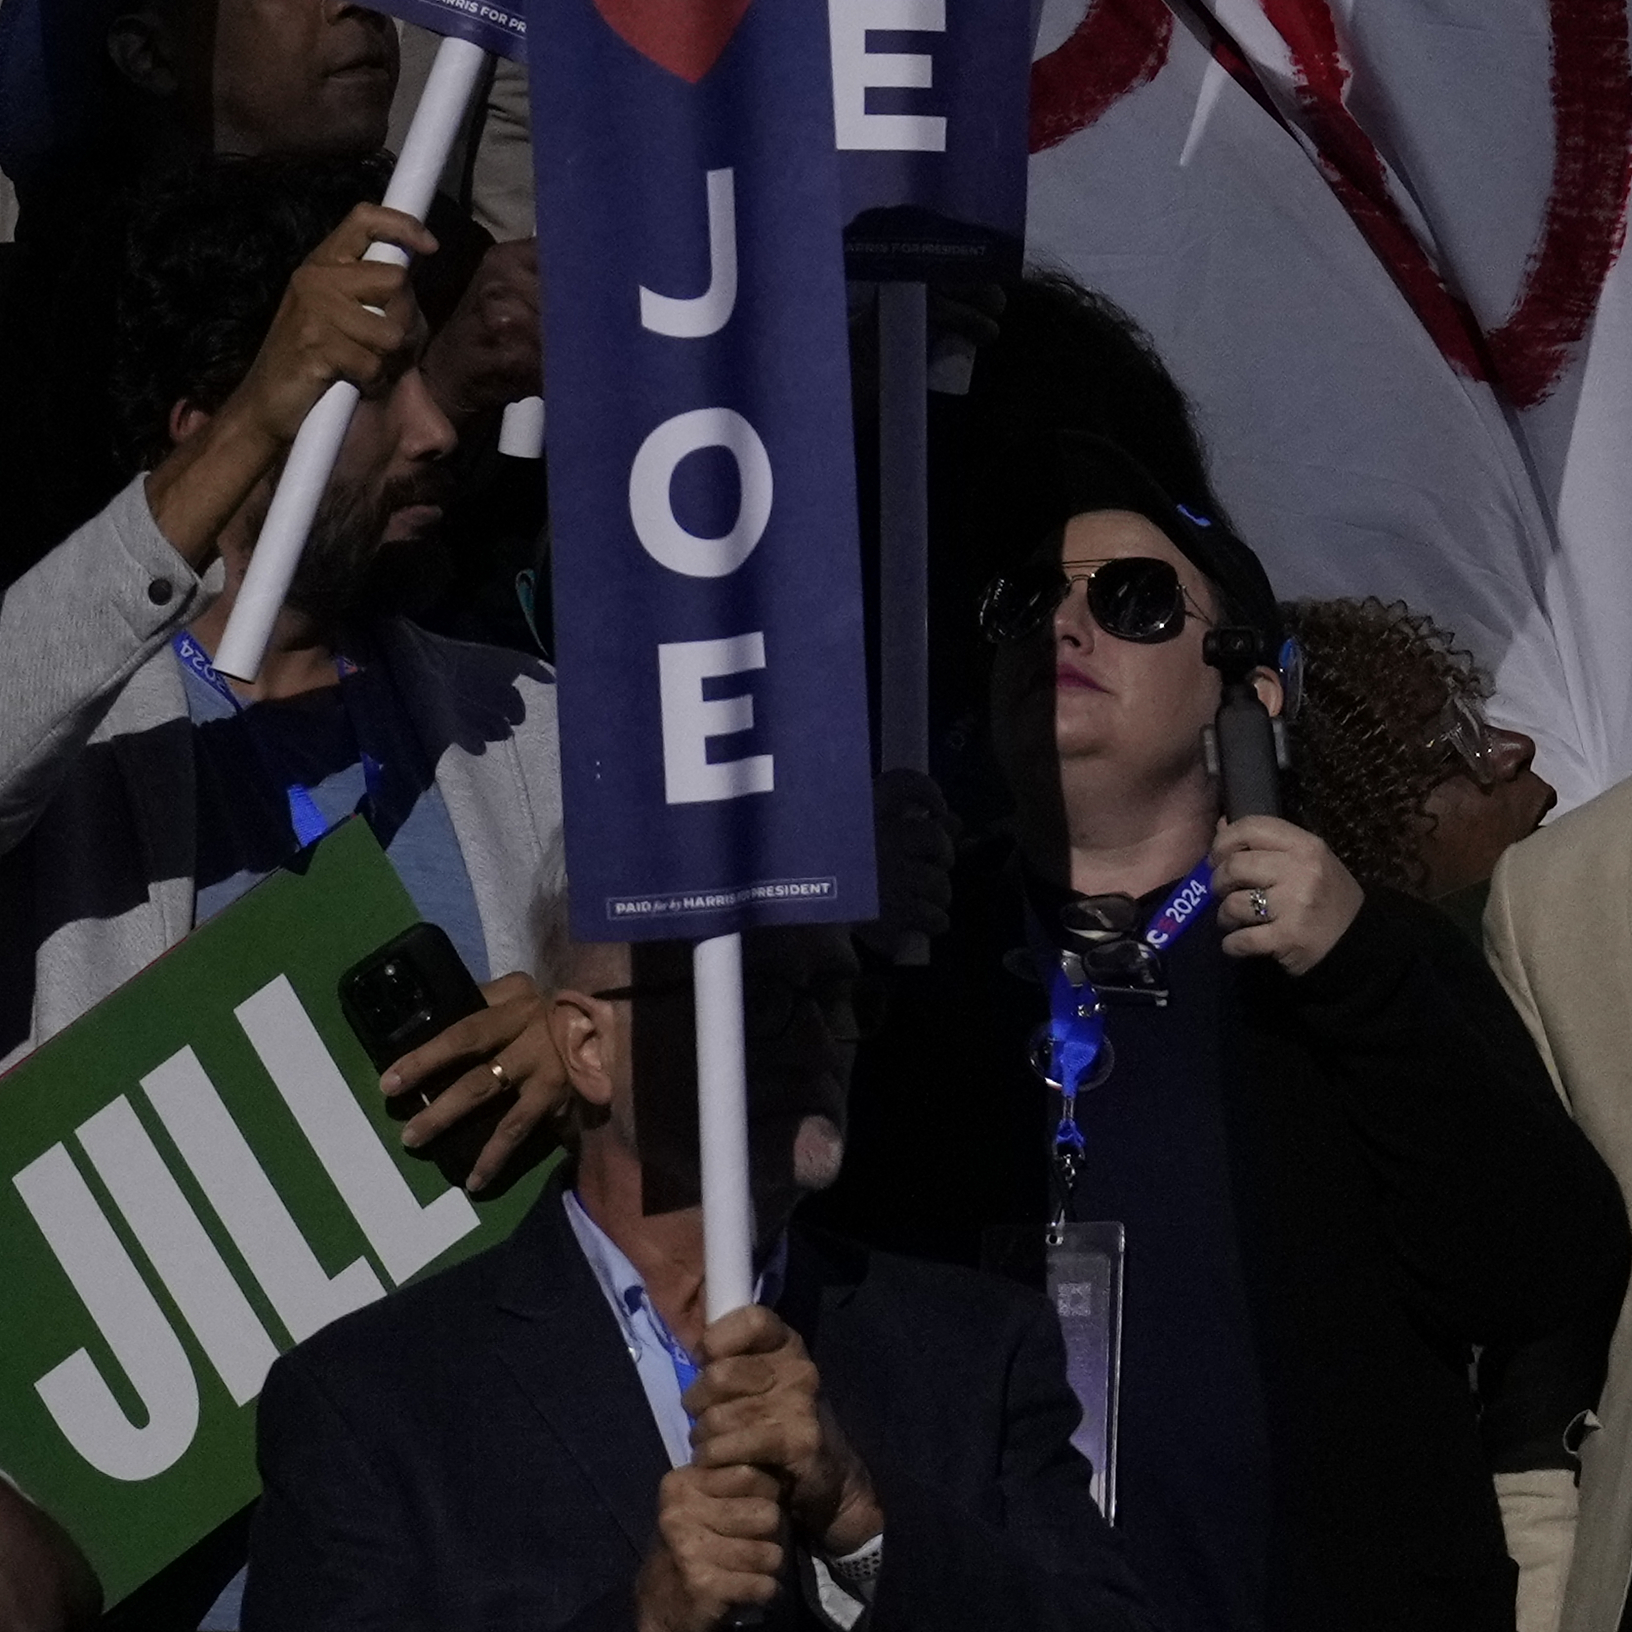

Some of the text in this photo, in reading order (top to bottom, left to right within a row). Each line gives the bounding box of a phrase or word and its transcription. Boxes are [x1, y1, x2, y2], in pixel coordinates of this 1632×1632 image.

[480, 5, 508, 26] FOR
[628, 168, 775, 805] JOE
[614, 899, 652, 915] PAID
[683, 891, 736, 910] HARRIS
[751, 880, 832, 899] PRESIDENT
[1165, 879, 1207, 923] 2024
[12, 972, 482, 1482] JILL
